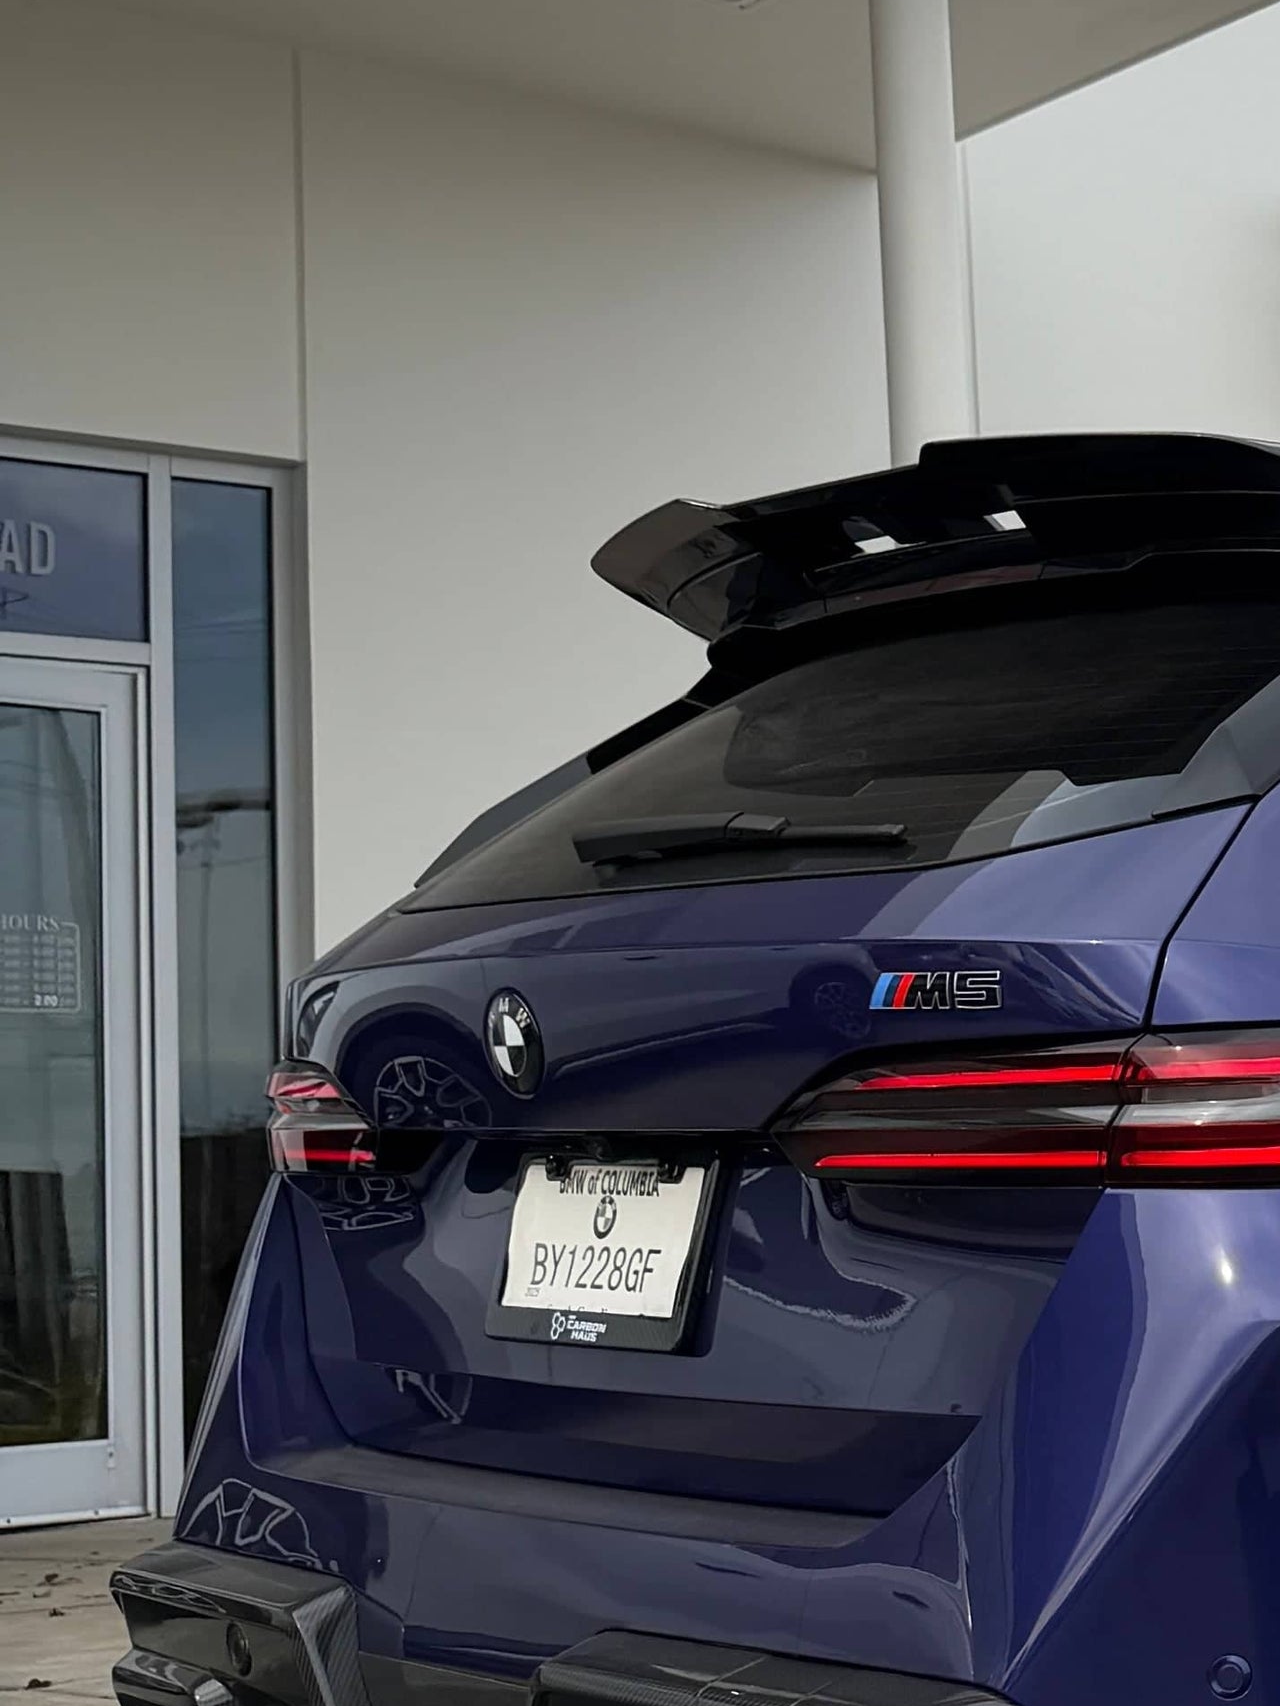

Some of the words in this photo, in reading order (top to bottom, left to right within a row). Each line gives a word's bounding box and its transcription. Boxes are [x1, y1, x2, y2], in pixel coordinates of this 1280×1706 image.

[903, 970, 1002, 1010] M5
[587, 1168, 602, 1195] of
[601, 1169, 659, 1197] COLUMBIA
[530, 1243, 661, 1293] BY1228GF
[566, 1320, 606, 1333] CARBON
[570, 1330, 598, 1343] HAUS
